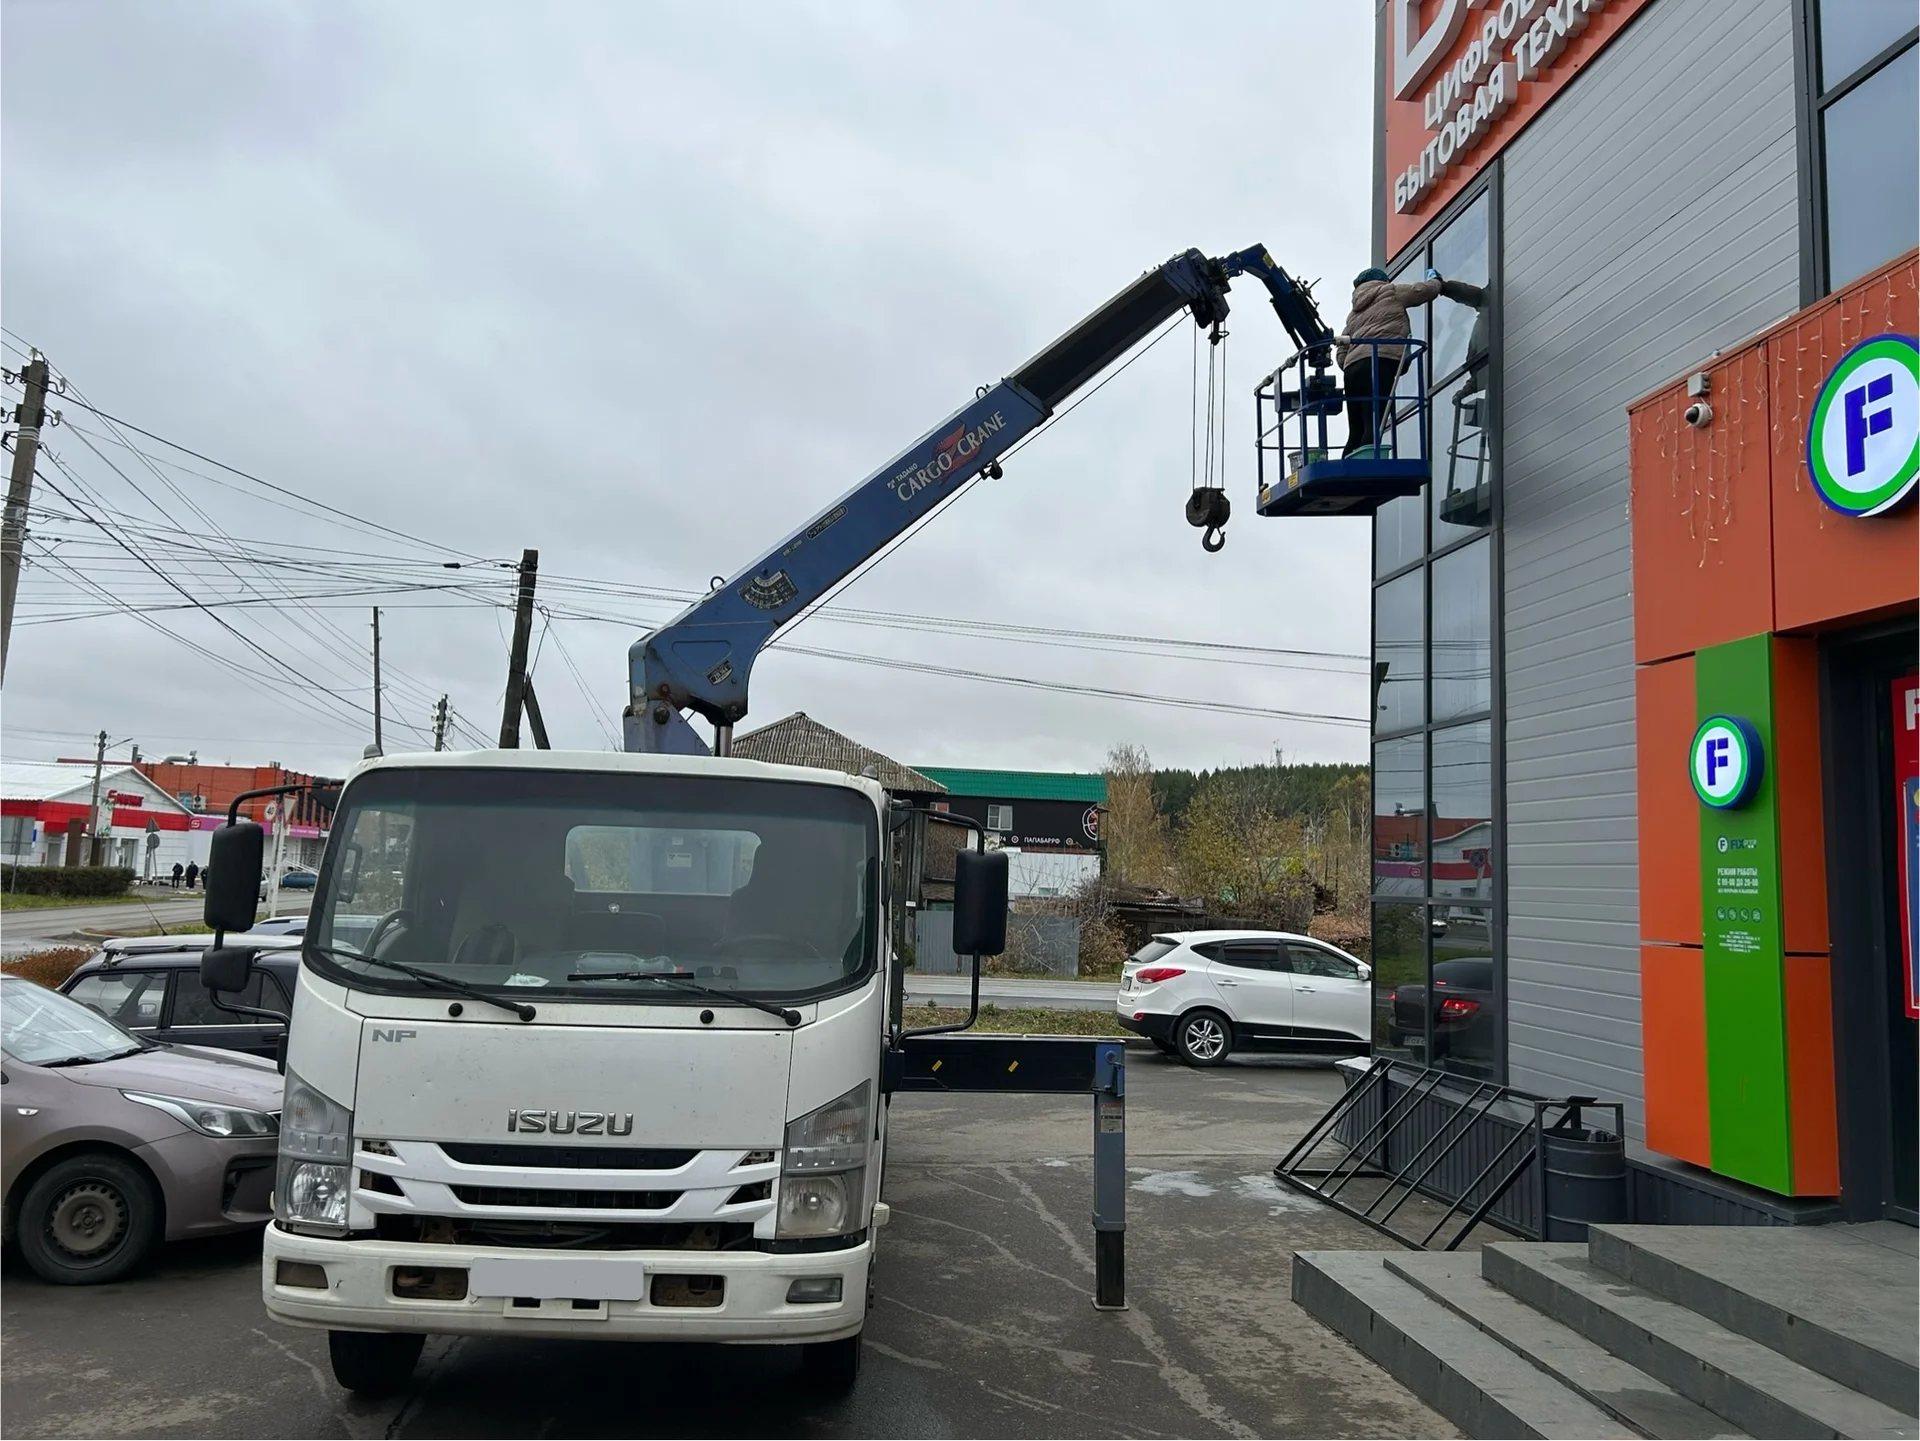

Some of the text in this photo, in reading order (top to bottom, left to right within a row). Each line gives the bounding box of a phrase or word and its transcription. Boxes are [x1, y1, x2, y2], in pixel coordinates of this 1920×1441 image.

[1395, 62, 1505, 214] БЫТОВАЯ
[1844, 373, 1893, 477] F
[895, 462, 918, 482] TADANO
[897, 410, 1007, 501] CARGO CRANE
[1706, 737, 1729, 786] F
[372, 1029, 417, 1043] NP
[507, 1108, 634, 1136] ISUZU
